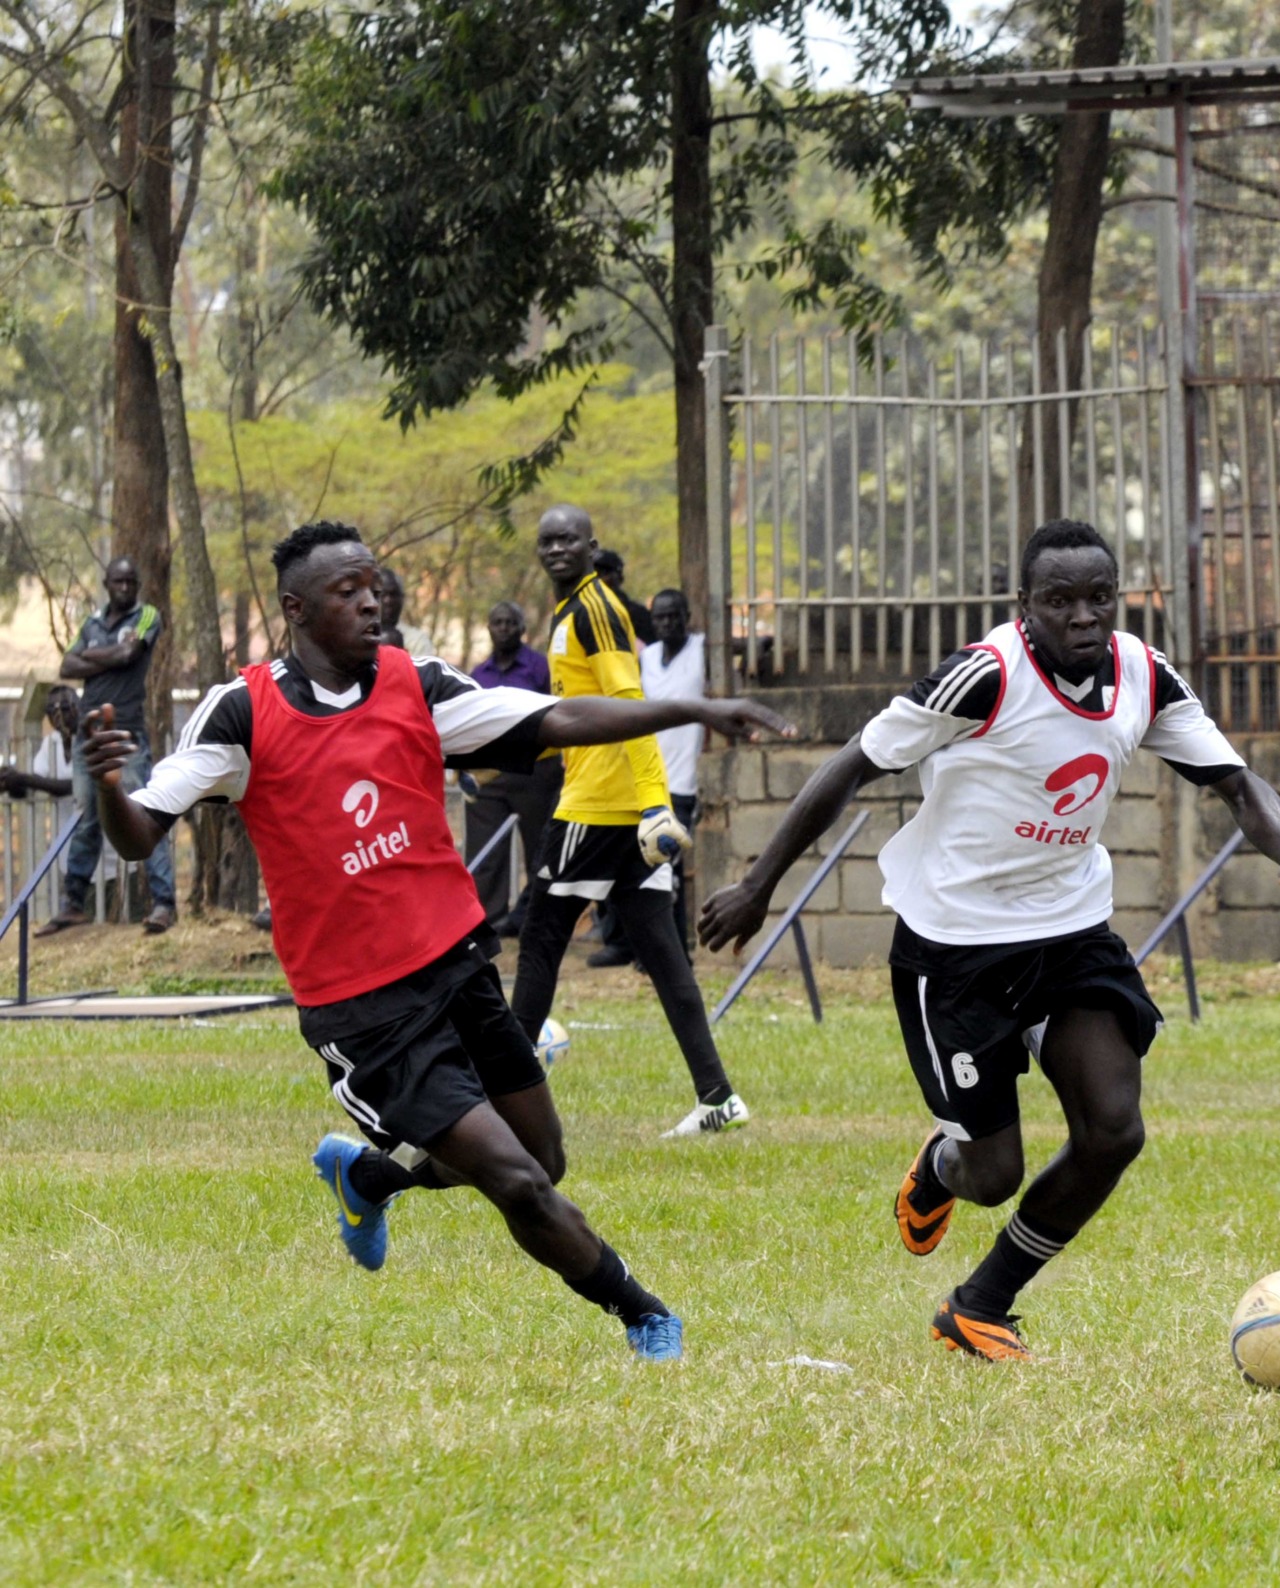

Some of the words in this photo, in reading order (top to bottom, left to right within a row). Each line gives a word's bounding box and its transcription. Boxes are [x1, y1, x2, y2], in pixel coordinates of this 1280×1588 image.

[341, 821, 412, 876] airtel
[1014, 820, 1092, 846] airtel
[951, 1051, 980, 1089] 6
[699, 1099, 741, 1132] NIKE
